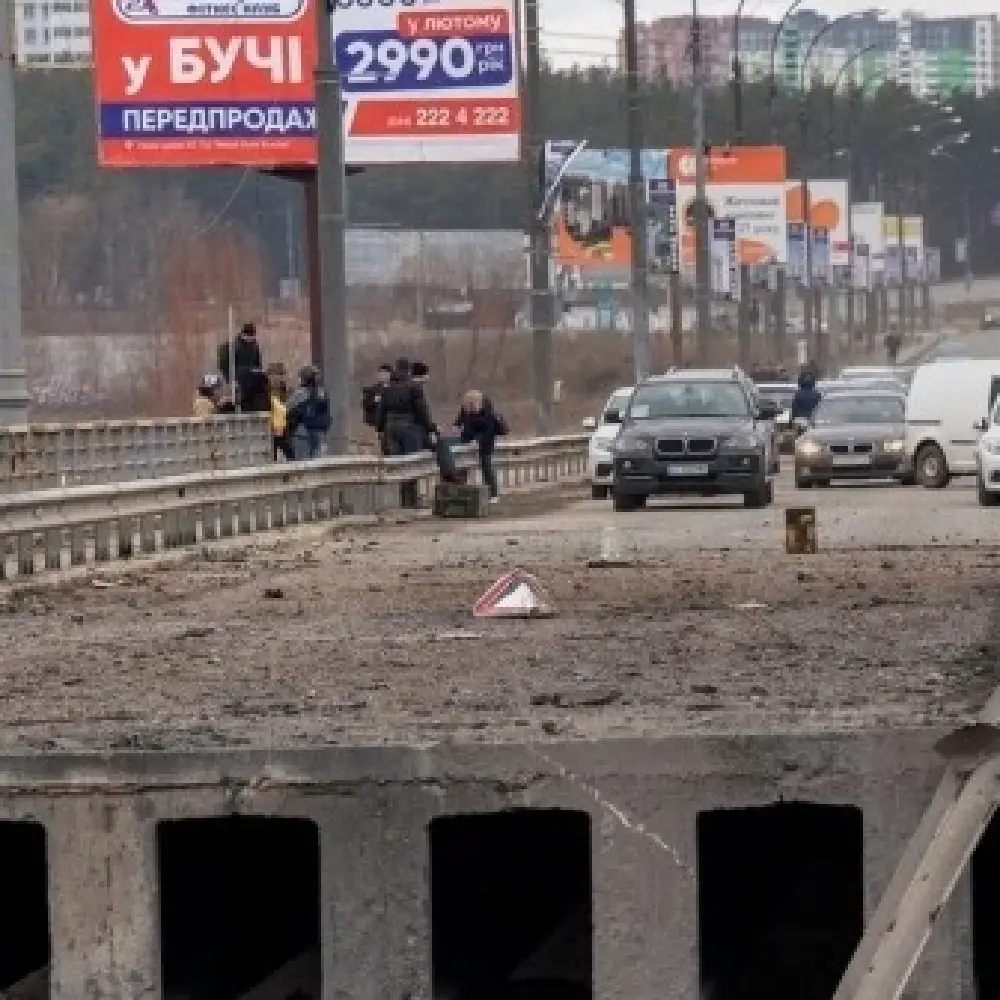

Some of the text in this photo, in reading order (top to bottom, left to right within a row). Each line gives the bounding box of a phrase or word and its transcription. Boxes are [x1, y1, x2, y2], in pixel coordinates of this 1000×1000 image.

[408, 17, 419, 36] у
[120, 35, 304, 96] у БУЧІ
[345, 38, 474, 83] 2990
[416, 107, 450, 126] 222
[455, 106, 468, 125] 4
